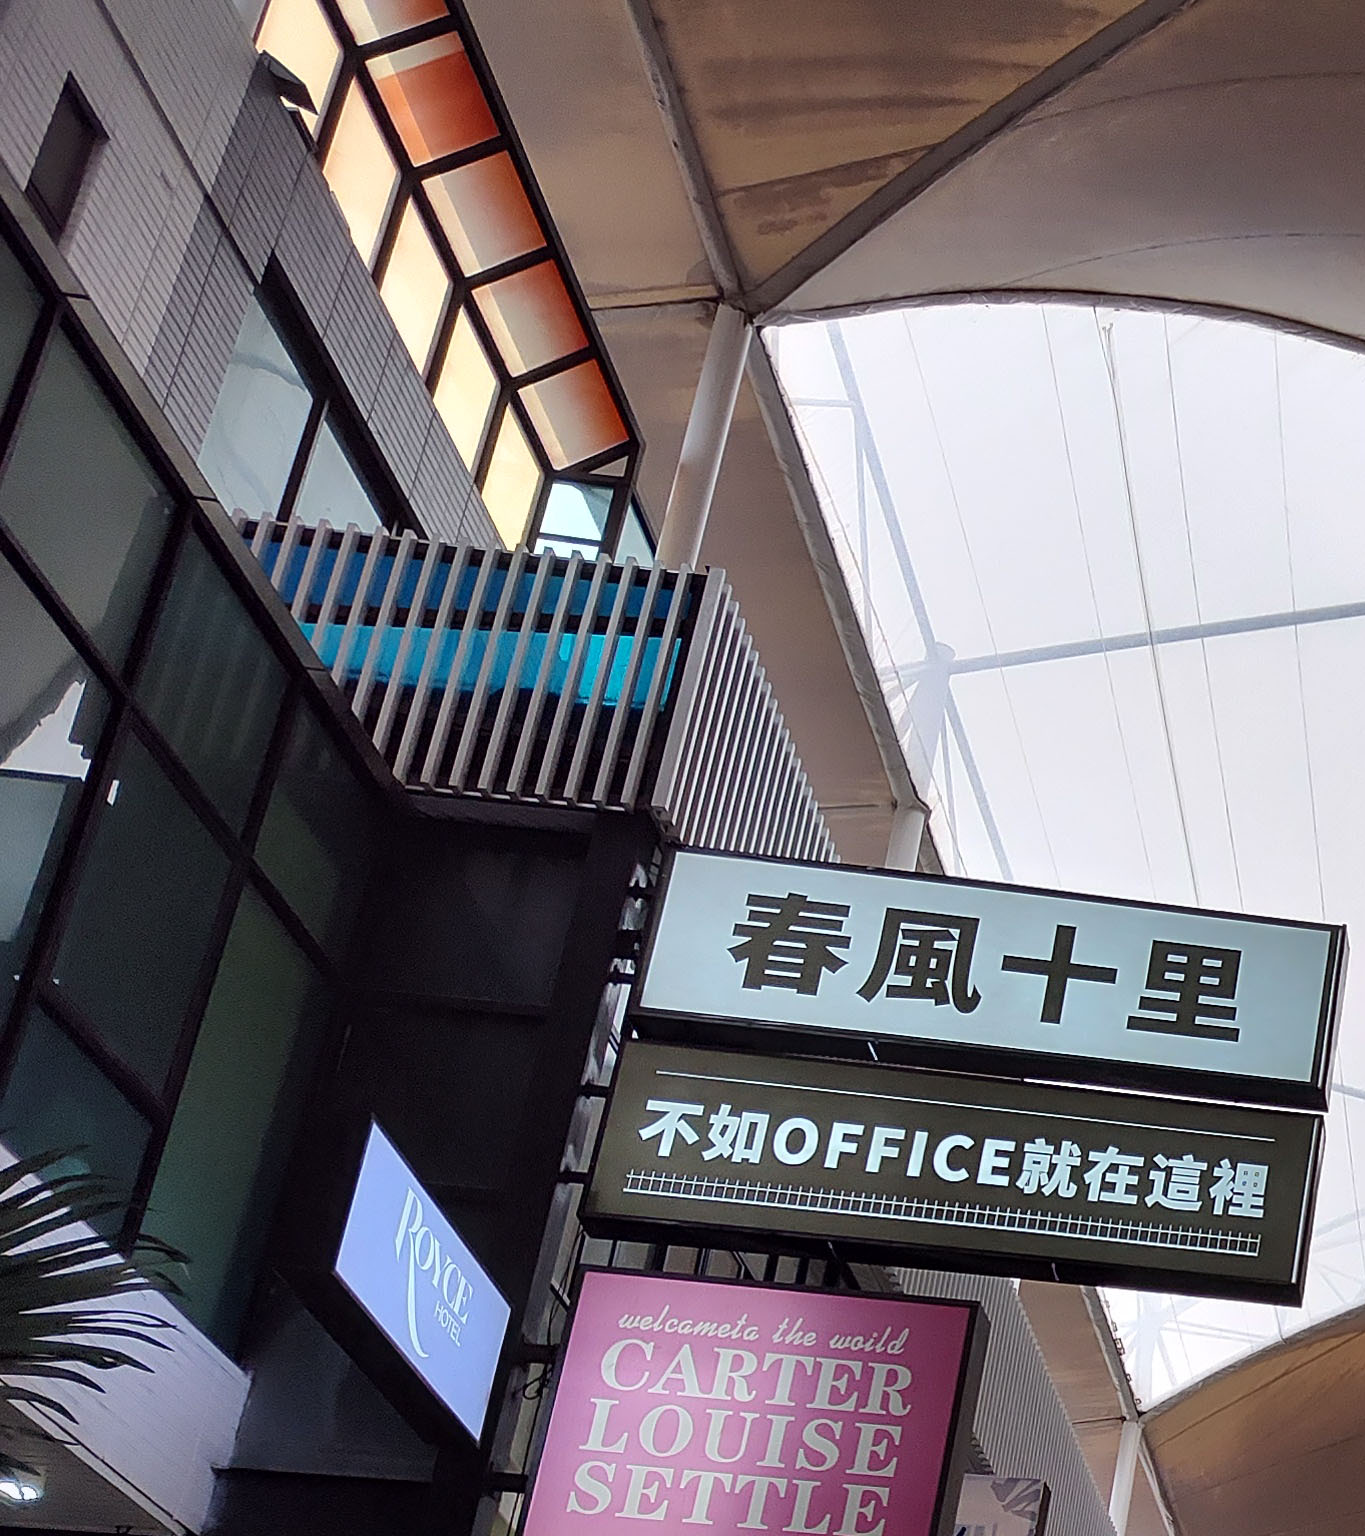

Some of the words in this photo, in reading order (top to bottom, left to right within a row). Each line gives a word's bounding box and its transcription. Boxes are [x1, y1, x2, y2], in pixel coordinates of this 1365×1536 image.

[727, 889, 1243, 1044] 春風十里
[637, 1095, 1270, 1220] 不如OFFICE就在這裡
[395, 1186, 474, 1358] ROYCE
[432, 1301, 462, 1348] HOTEL
[772, 1317, 818, 1347] the
[600, 1338, 913, 1417] CARTER
[578, 1397, 903, 1478] LOUISE
